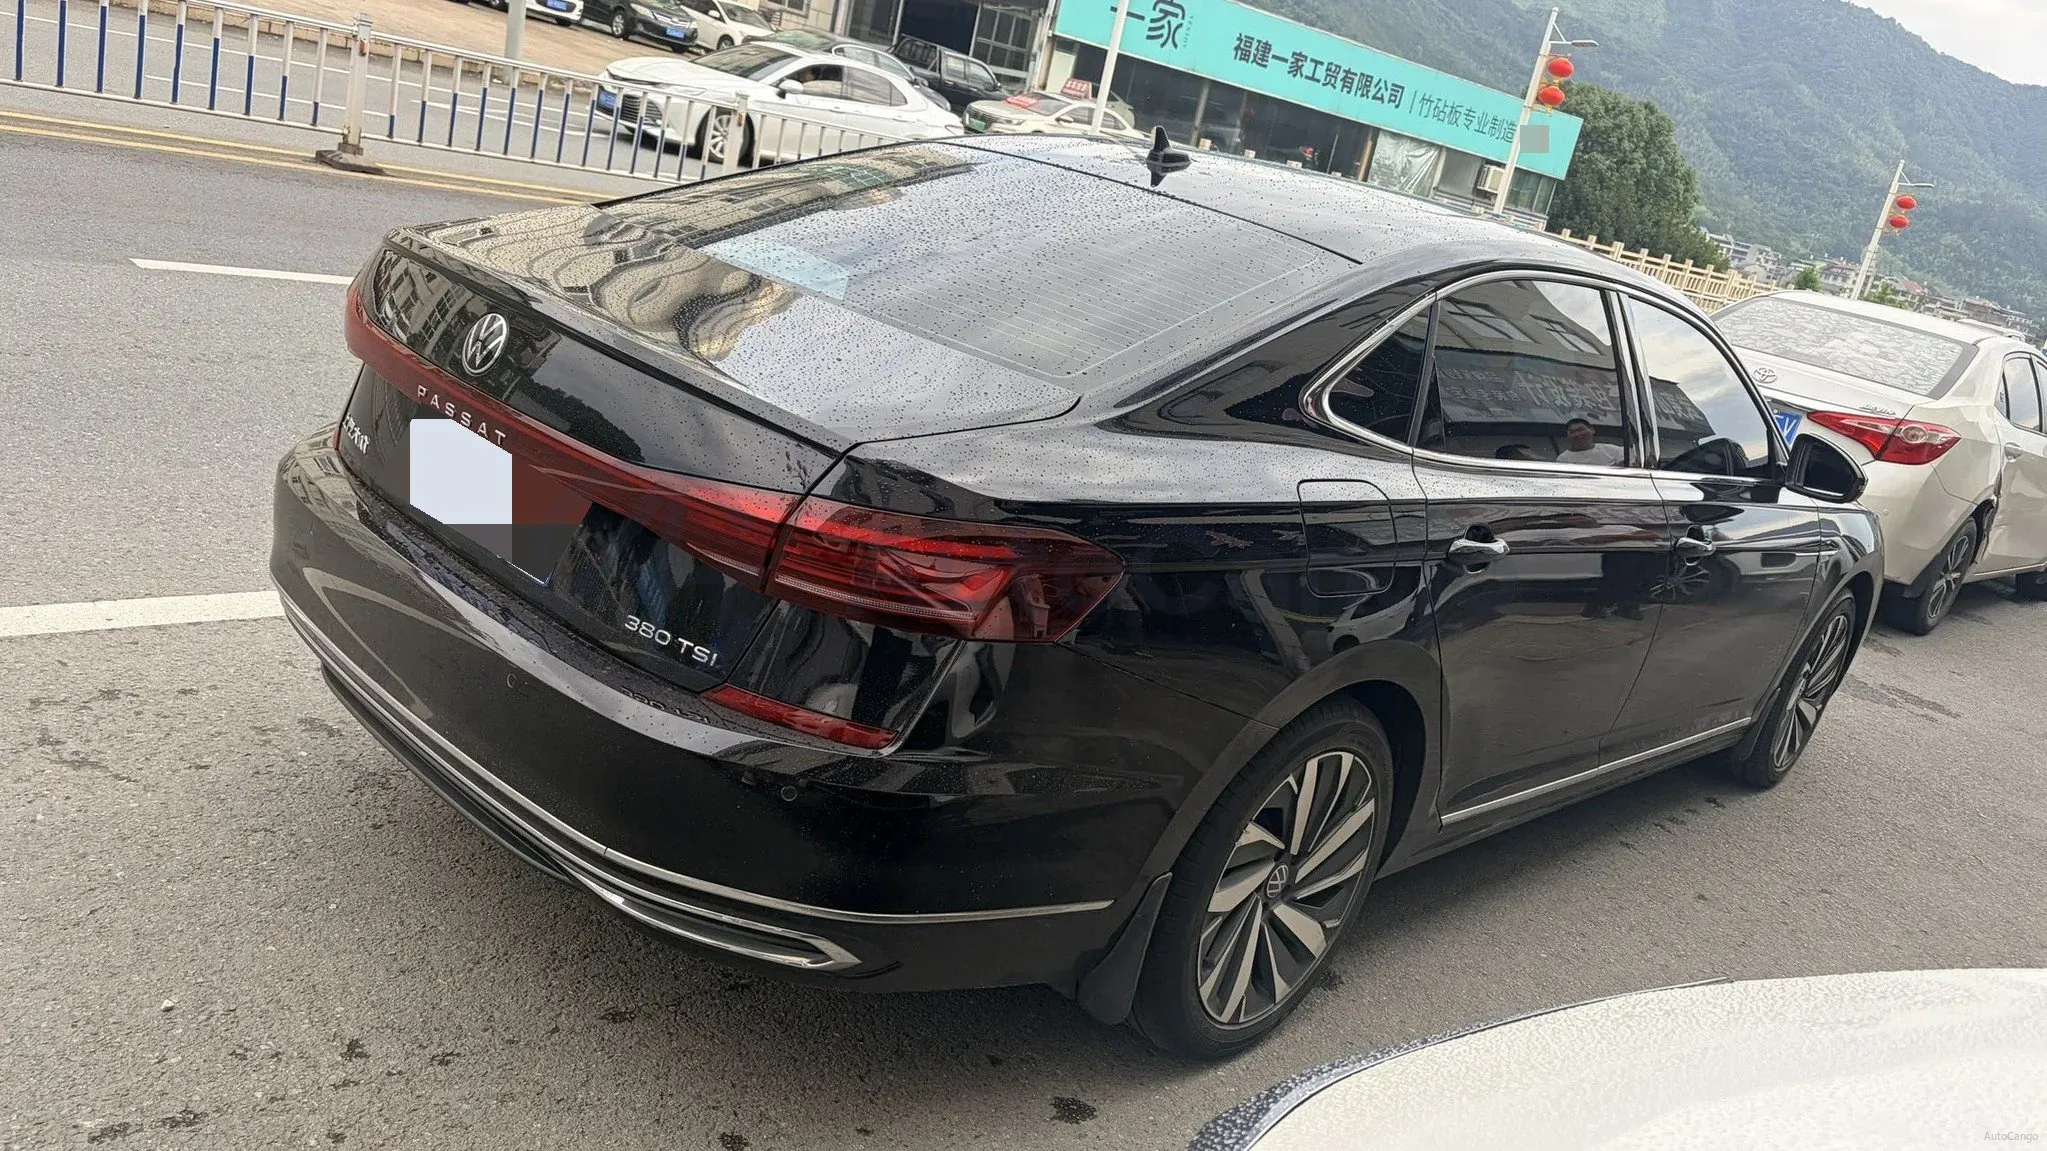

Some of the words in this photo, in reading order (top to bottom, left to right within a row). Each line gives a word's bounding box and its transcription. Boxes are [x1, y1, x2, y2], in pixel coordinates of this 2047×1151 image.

[1110, 0, 1186, 49] 一家
[1233, 33, 1406, 109] 福建一家工贸有限公司
[1418, 92, 1518, 144] 竹砧板专业制造
[417, 384, 507, 445] PASSAT
[624, 614, 671, 646] 380
[677, 637, 718, 667] TSI
